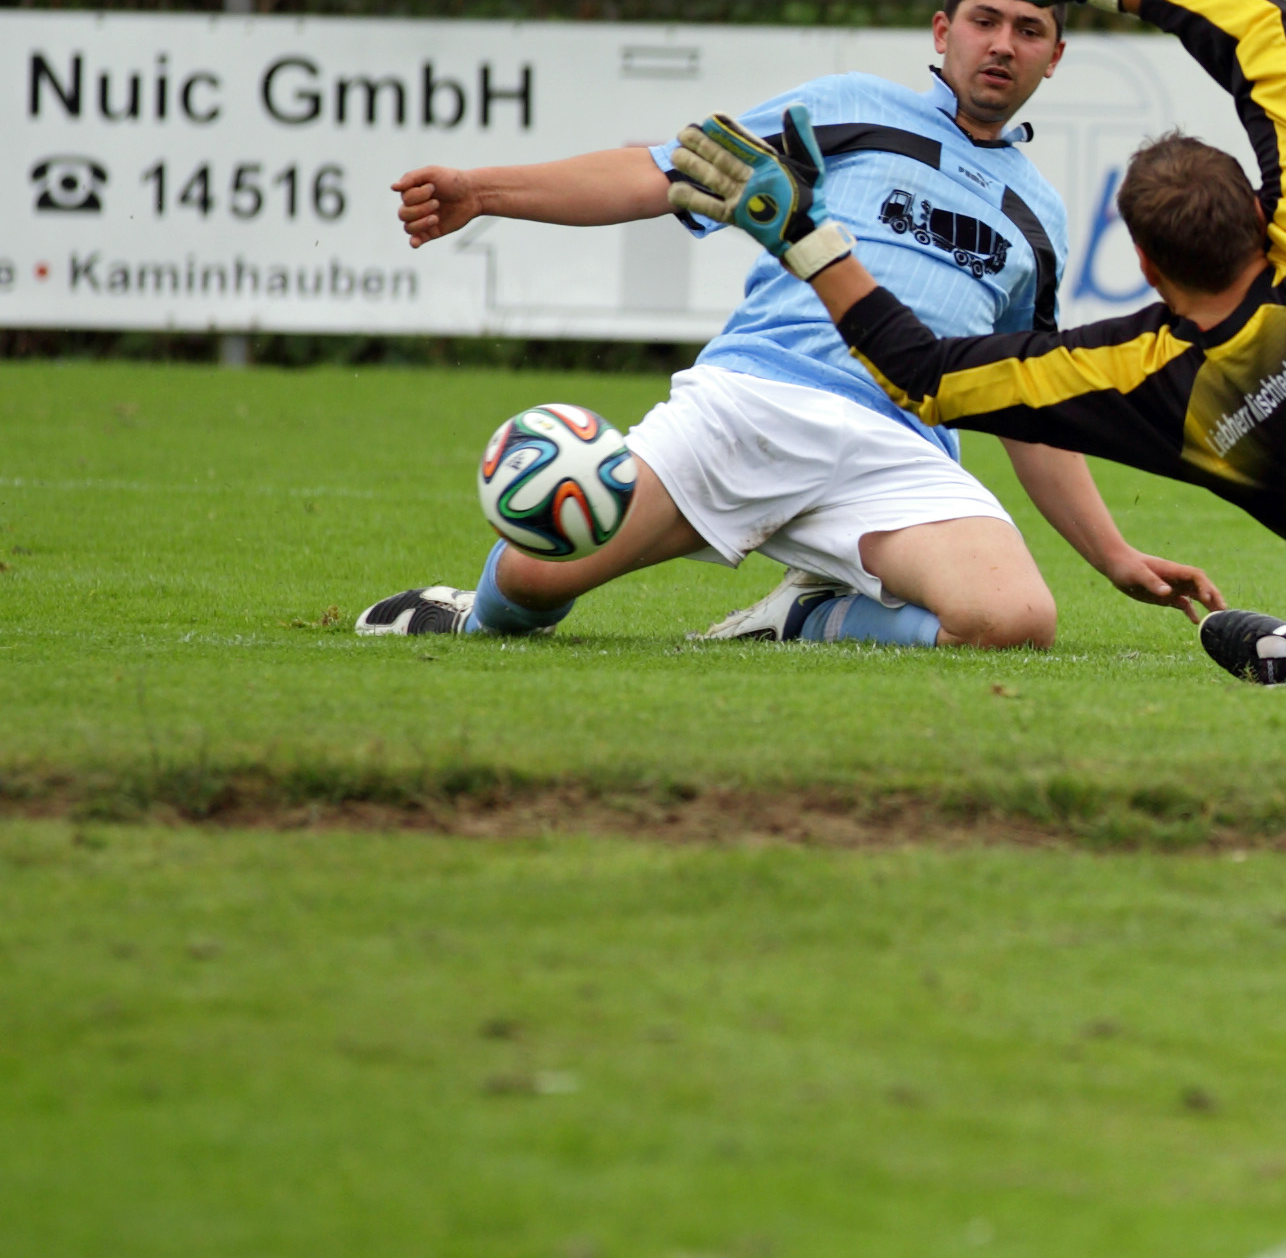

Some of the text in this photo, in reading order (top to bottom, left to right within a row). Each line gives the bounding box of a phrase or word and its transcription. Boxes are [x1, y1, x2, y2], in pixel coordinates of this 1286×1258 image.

[28, 50, 534, 130] Nuic GmbH
[140, 159, 348, 222] 14516
[69, 253, 418, 302] Kaminhauben
